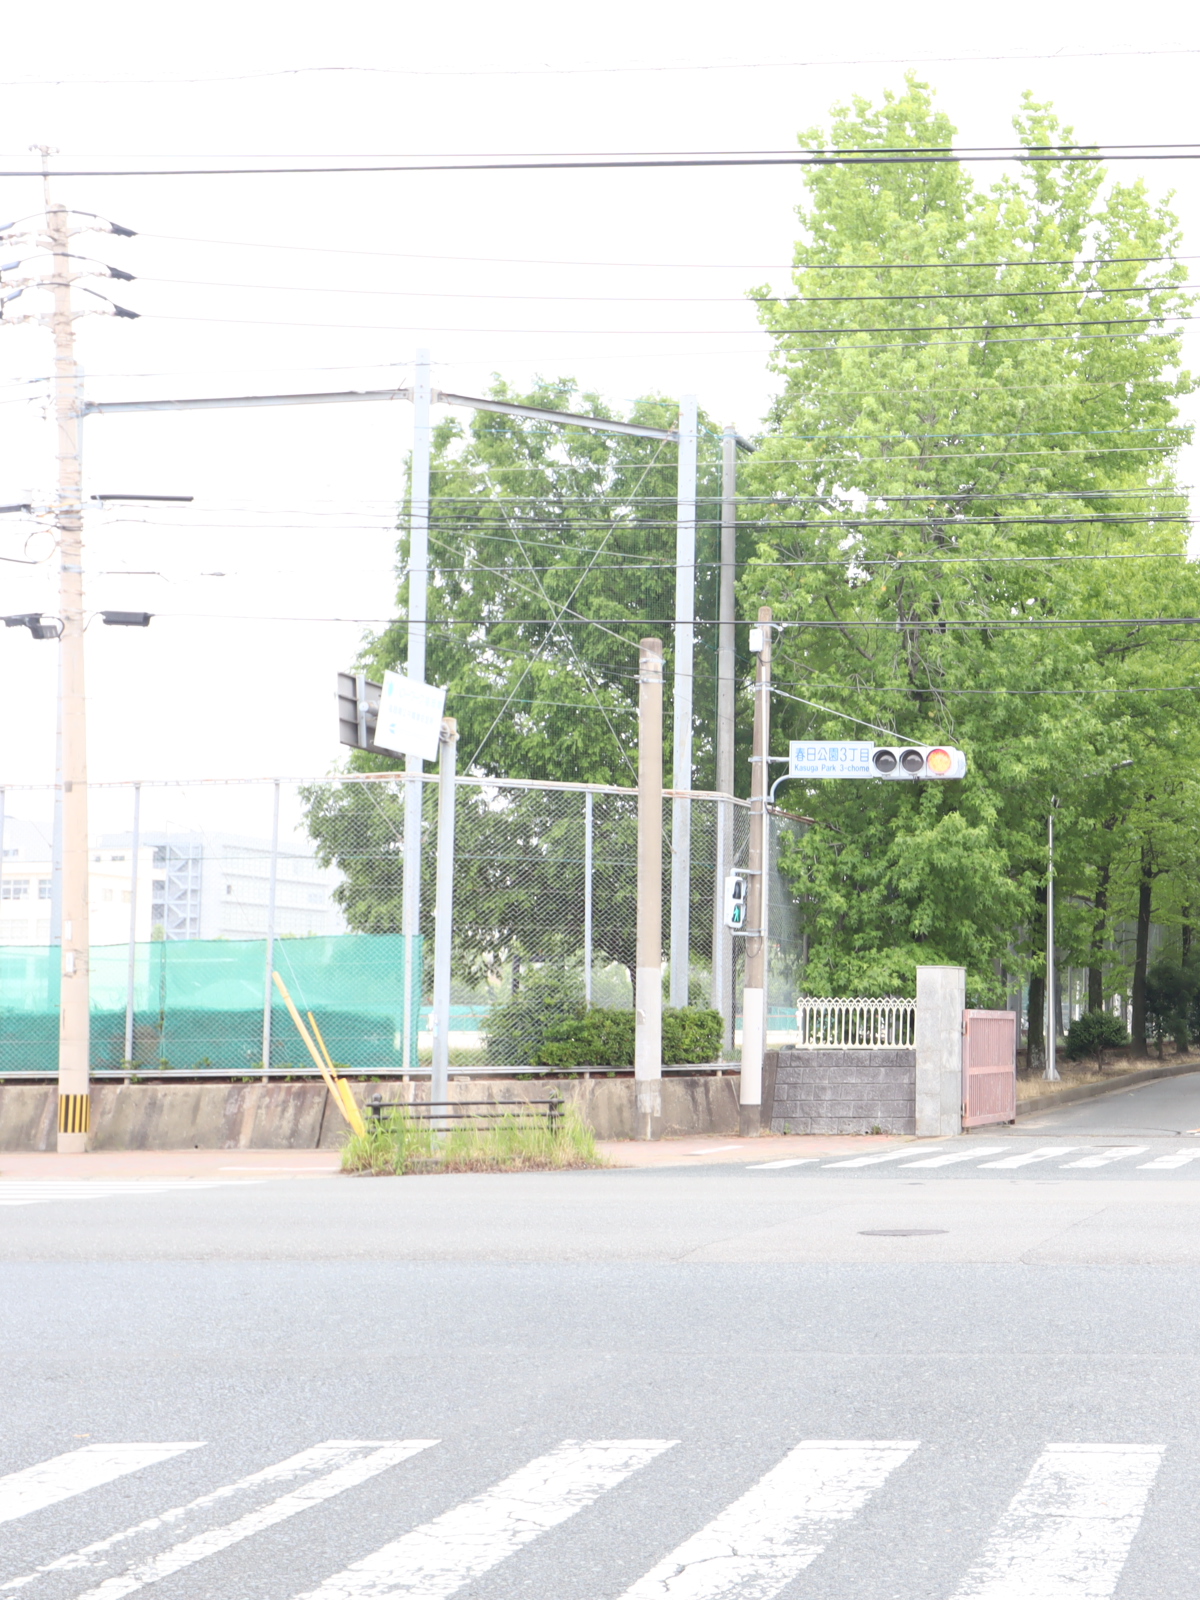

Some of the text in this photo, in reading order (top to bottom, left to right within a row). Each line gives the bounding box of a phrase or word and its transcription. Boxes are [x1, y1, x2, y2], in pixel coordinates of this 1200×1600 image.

[795, 747, 870, 762] 春日公園3丁目
[795, 764, 870, 773] Kasuga Park 3-chome
